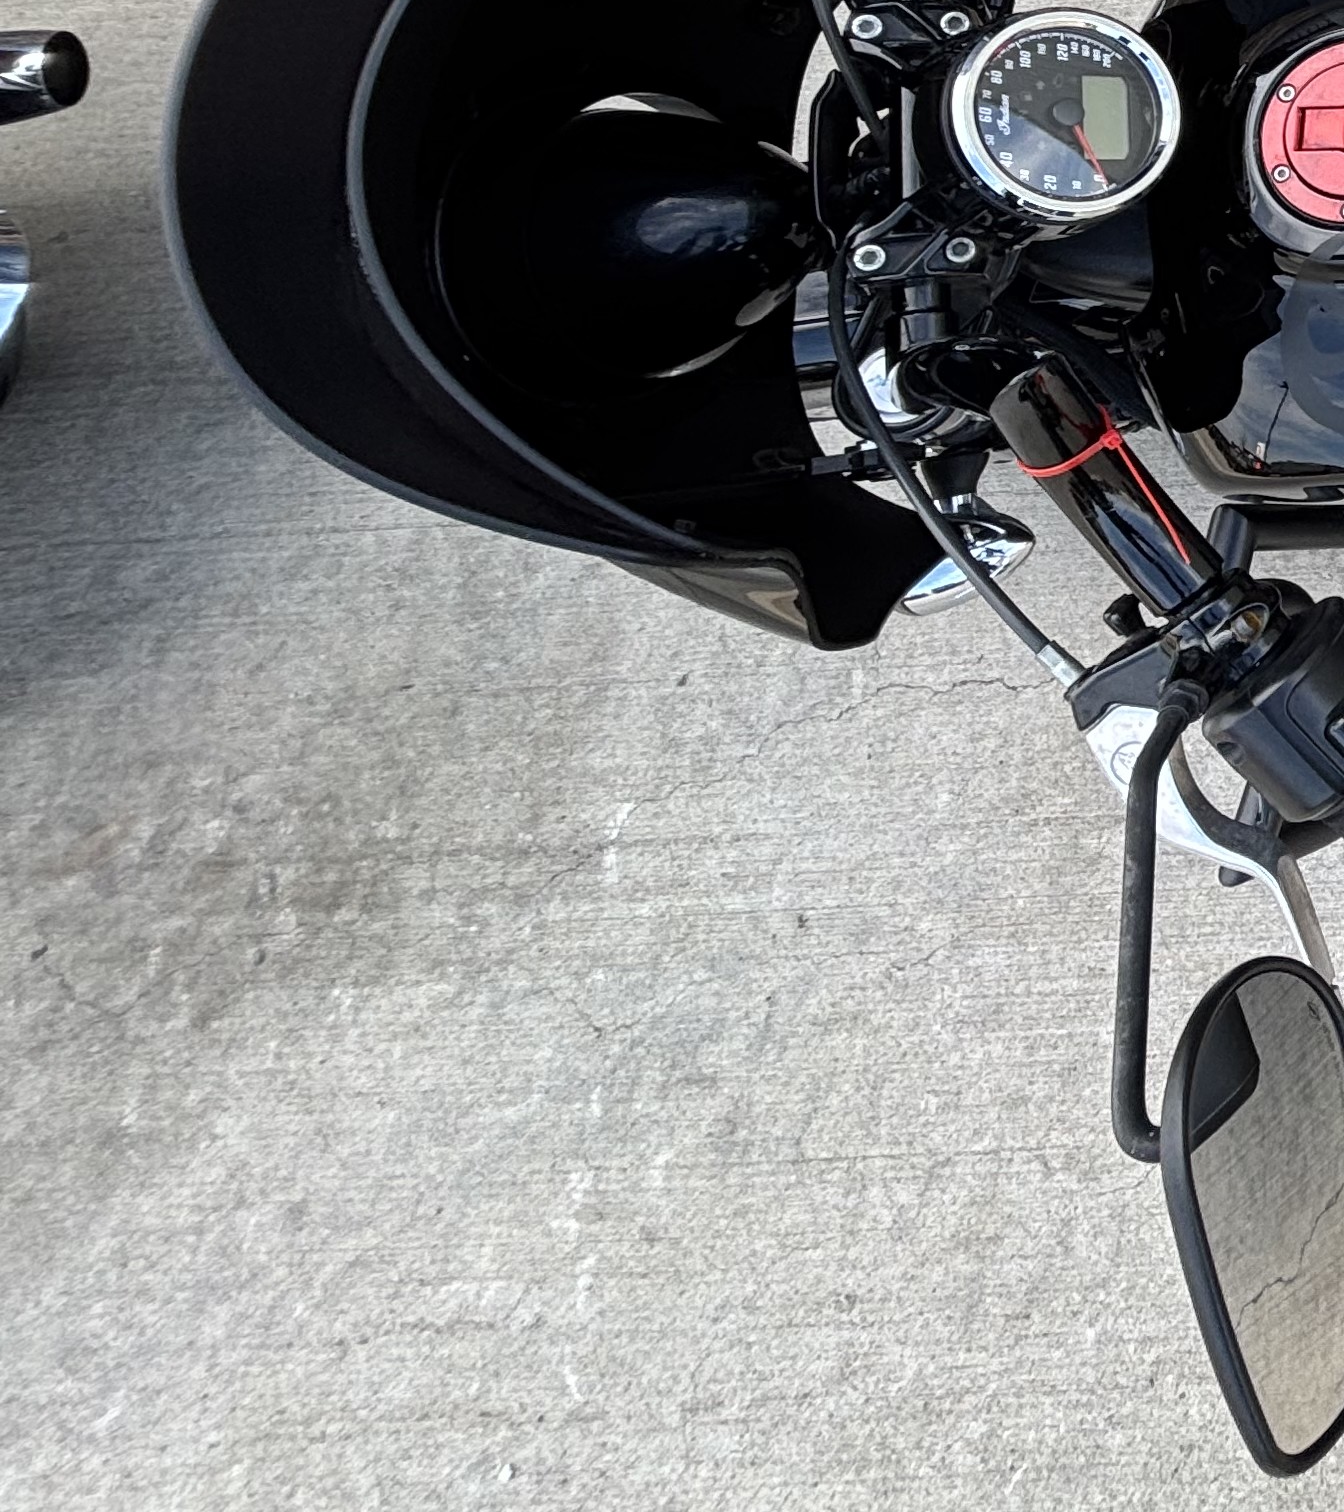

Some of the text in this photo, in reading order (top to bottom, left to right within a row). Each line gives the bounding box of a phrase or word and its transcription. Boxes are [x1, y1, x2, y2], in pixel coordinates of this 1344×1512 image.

[1019, 50, 1031, 68] 100
[1056, 43, 1069, 61] 120
[990, 70, 1003, 84] 80
[982, 89, 992, 99] 70
[978, 106, 993, 123] 60
[996, 93, 1011, 136] Indian
[984, 134, 995, 146] 50
[1000, 151, 1014, 168] 40
[1043, 174, 1057, 191] 20
